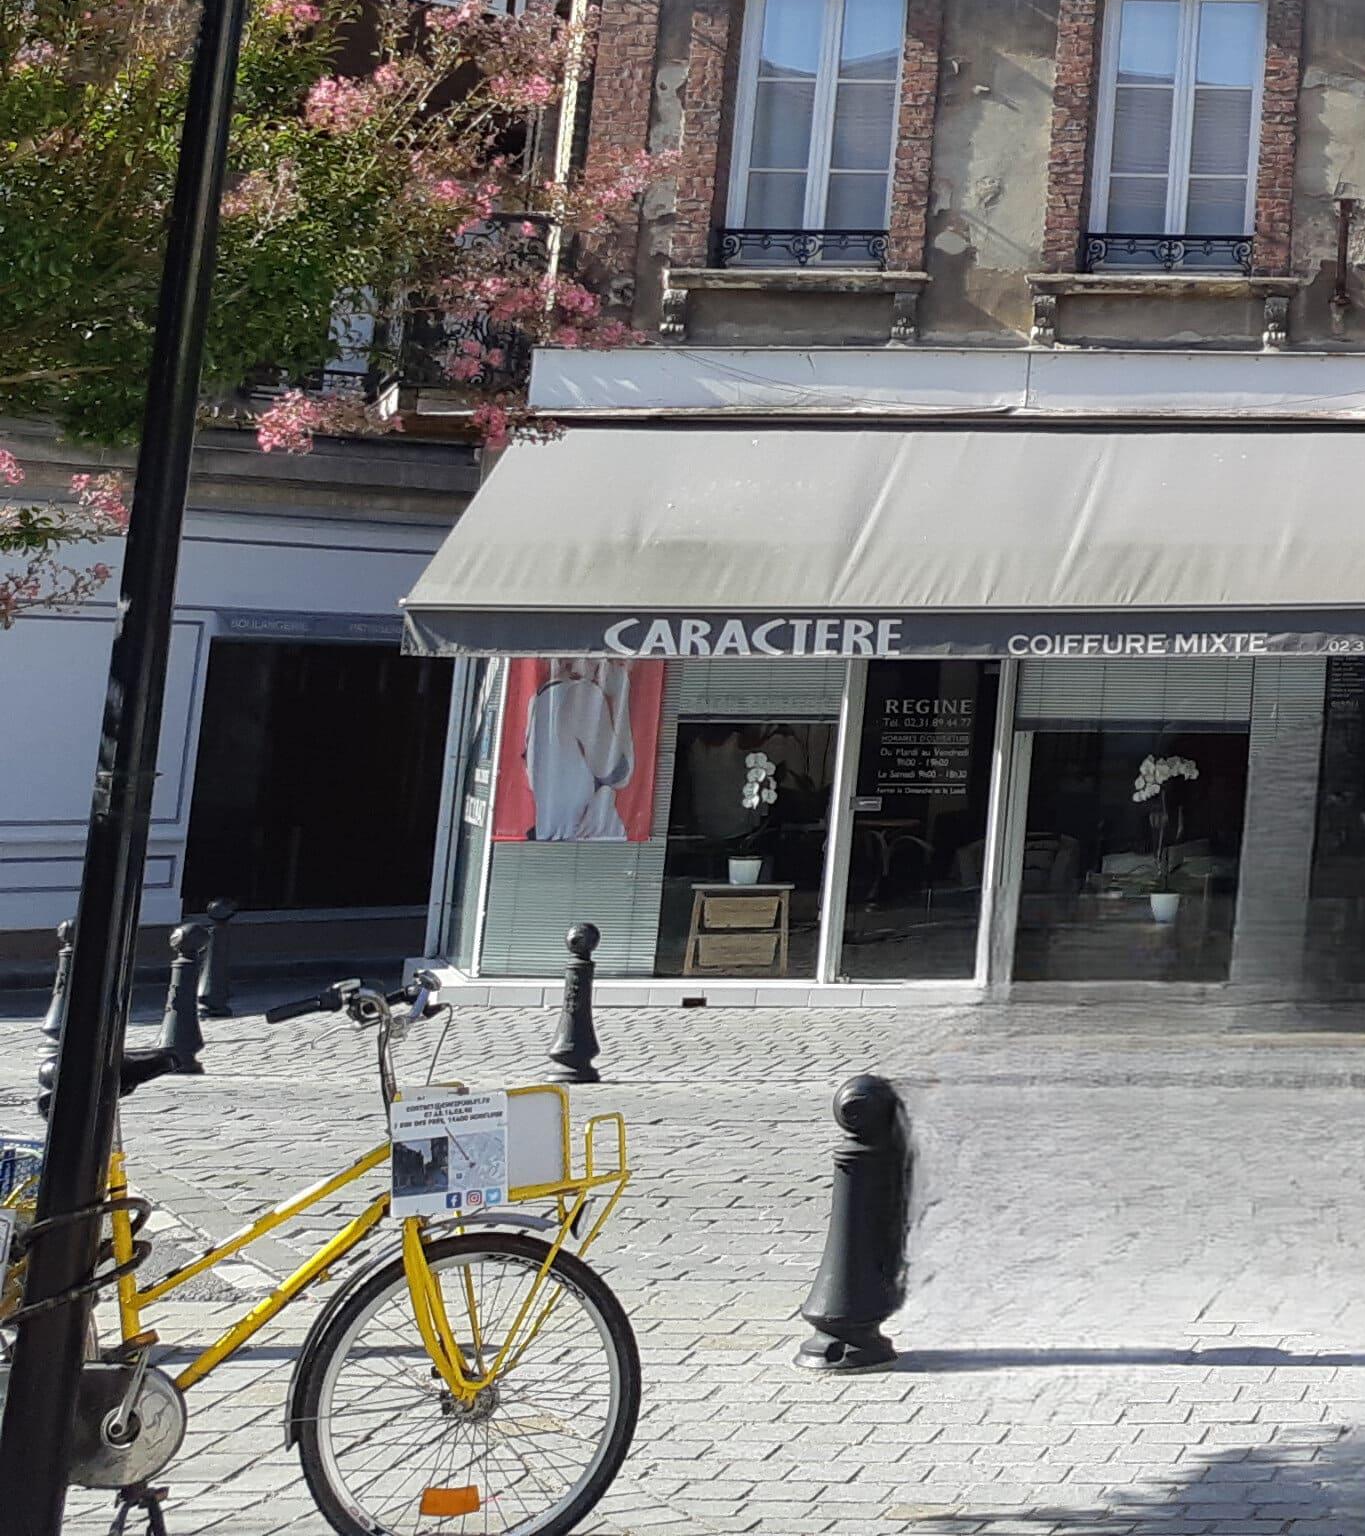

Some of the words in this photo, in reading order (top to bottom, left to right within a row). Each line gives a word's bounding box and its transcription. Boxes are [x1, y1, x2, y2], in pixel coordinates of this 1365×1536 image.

[603, 617, 902, 657] CARACTERE
[1007, 633, 1166, 655] COIFFURE
[1174, 632, 1268, 654] MIXTE
[1329, 639, 1350, 652] 02
[885, 699, 973, 714] REGINE
